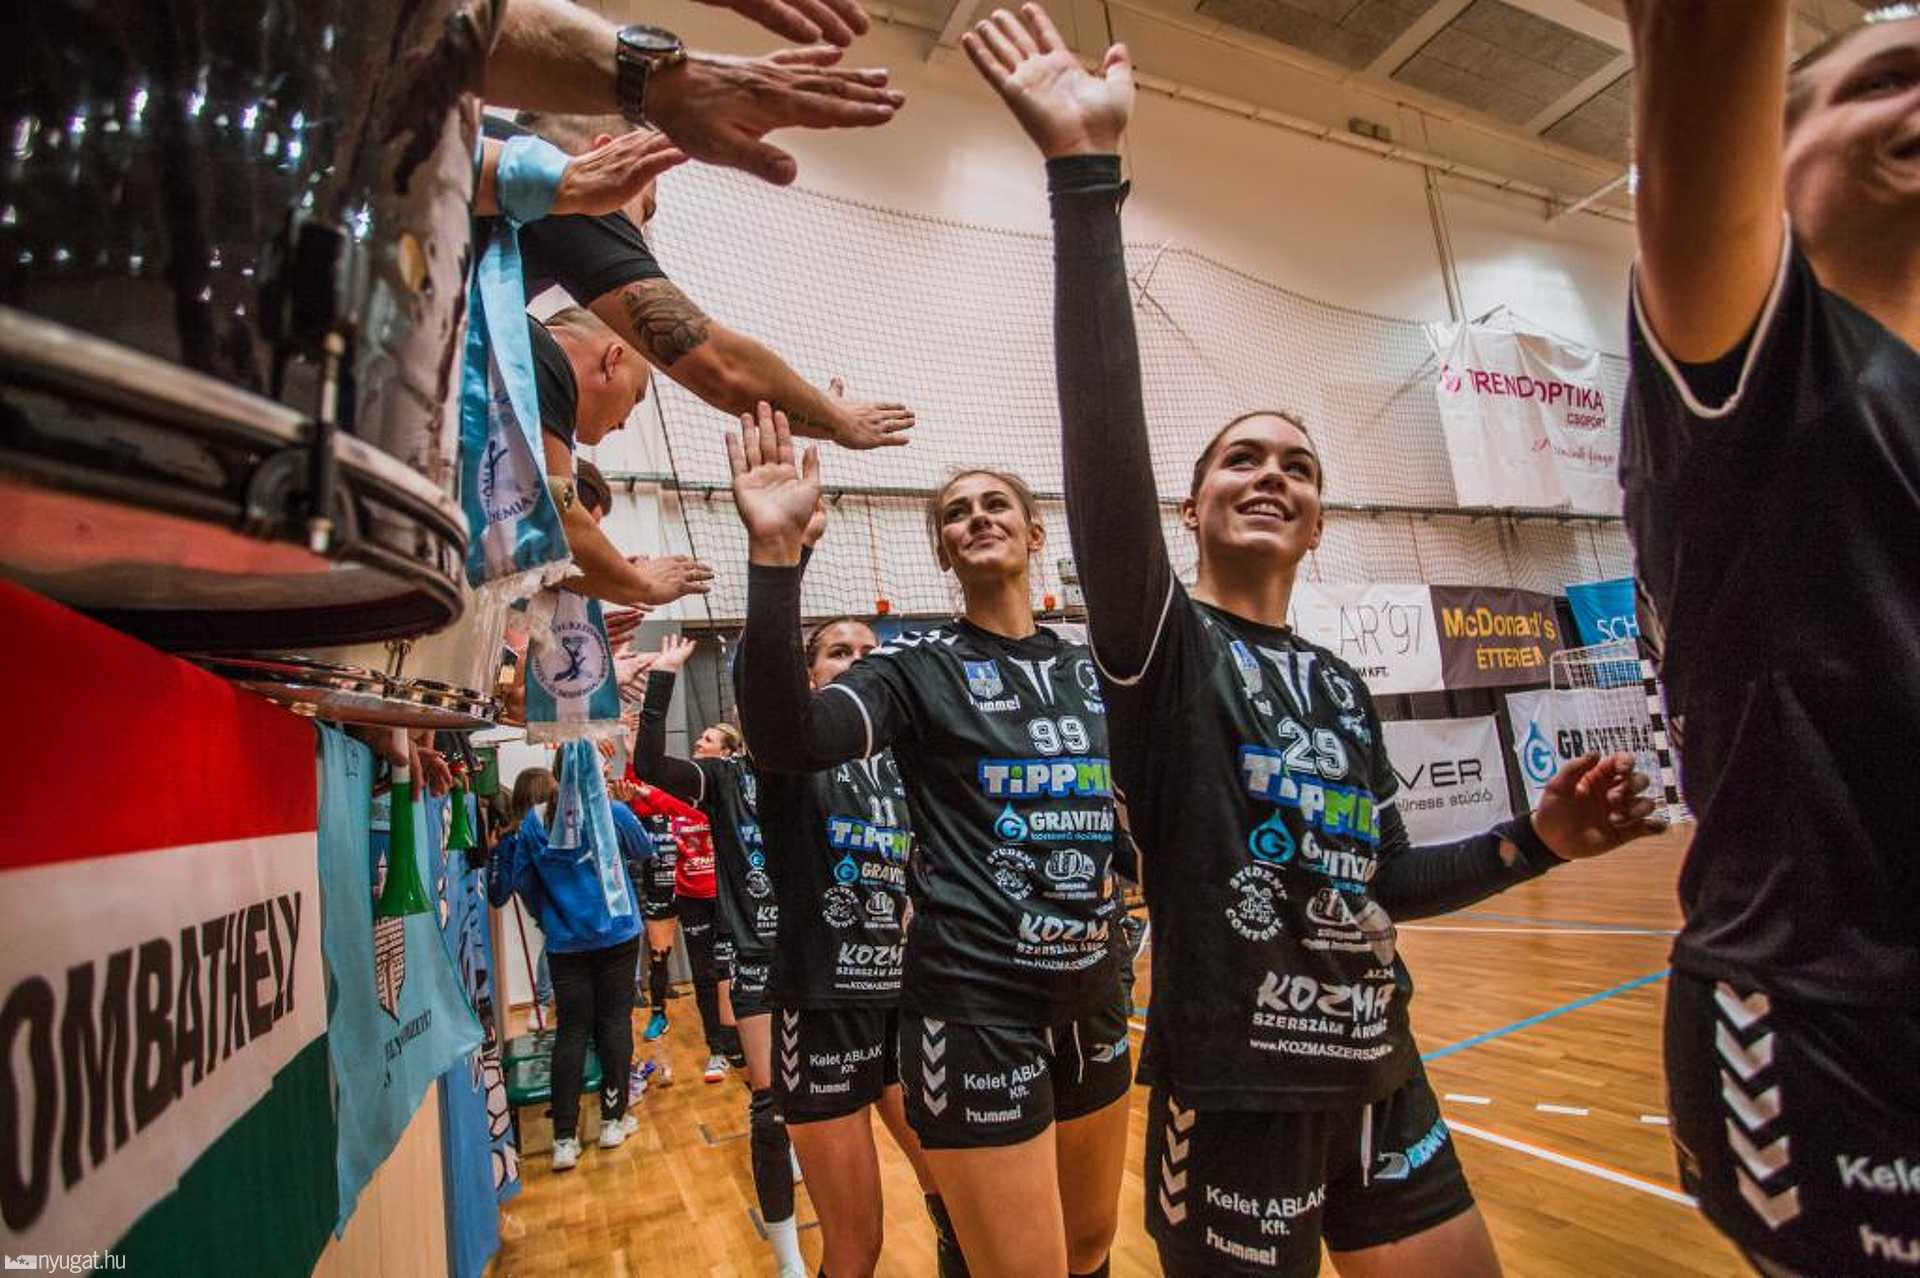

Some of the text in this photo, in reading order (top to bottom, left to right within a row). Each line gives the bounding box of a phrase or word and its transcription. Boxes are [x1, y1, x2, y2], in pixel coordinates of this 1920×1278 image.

[1027, 715, 1090, 756] 99
[1277, 716, 1349, 781] 29
[1257, 971, 1396, 1023] KOZMA
[1252, 1012, 1345, 1035] SZERSZÁM
[0, 890, 302, 1234] OMBATHELY
[964, 1073, 1008, 1090] Kelet
[966, 1104, 1022, 1123] hummel
[1206, 1183, 1327, 1217] Kelet ABLAK
[1206, 1226, 1277, 1266] hummel
[1261, 1219, 1291, 1236] Kft.
